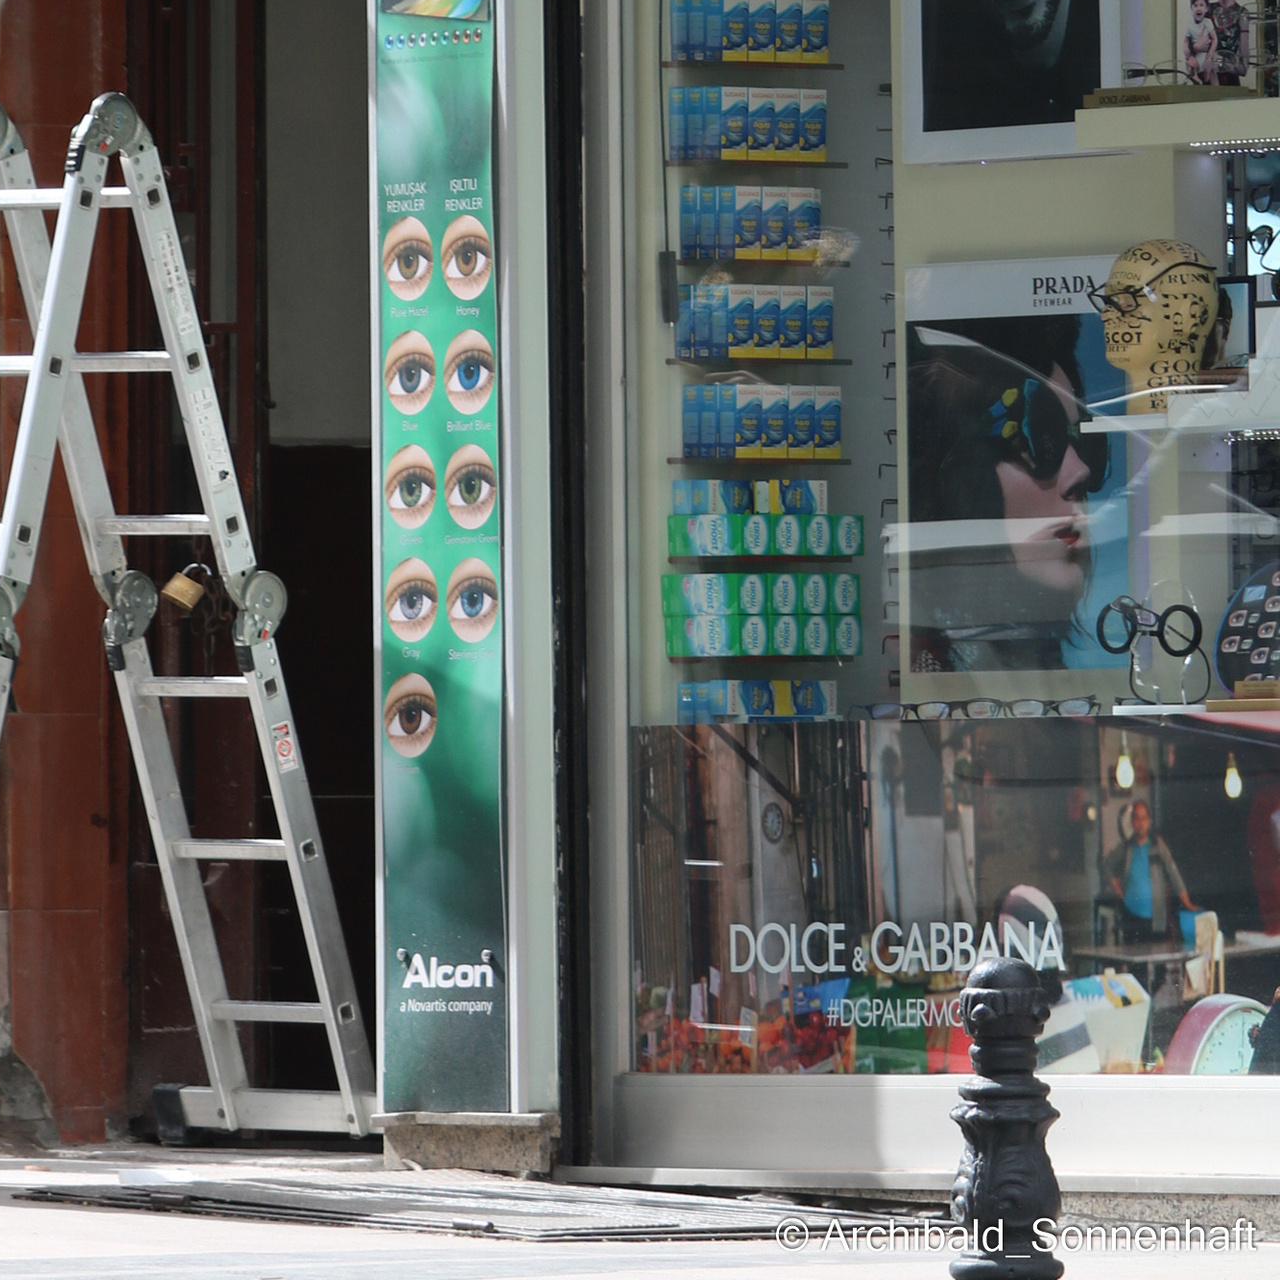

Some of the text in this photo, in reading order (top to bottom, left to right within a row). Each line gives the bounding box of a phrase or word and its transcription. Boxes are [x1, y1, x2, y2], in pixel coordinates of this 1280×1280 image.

[384, 182, 427, 197] YUMUŞAK
[386, 199, 425, 213] RENKLER
[445, 197, 482, 211] RENKLER
[1033, 275, 1095, 295] PRADA
[1033, 298, 1072, 307] EYEWEAR
[456, 306, 480, 317] Honey
[402, 646, 419, 660] Gray
[729, 921, 1066, 974] DOLCE & GABBANA
[402, 953, 493, 988] Alcon
[400, 999, 493, 1015] a Novartis company
